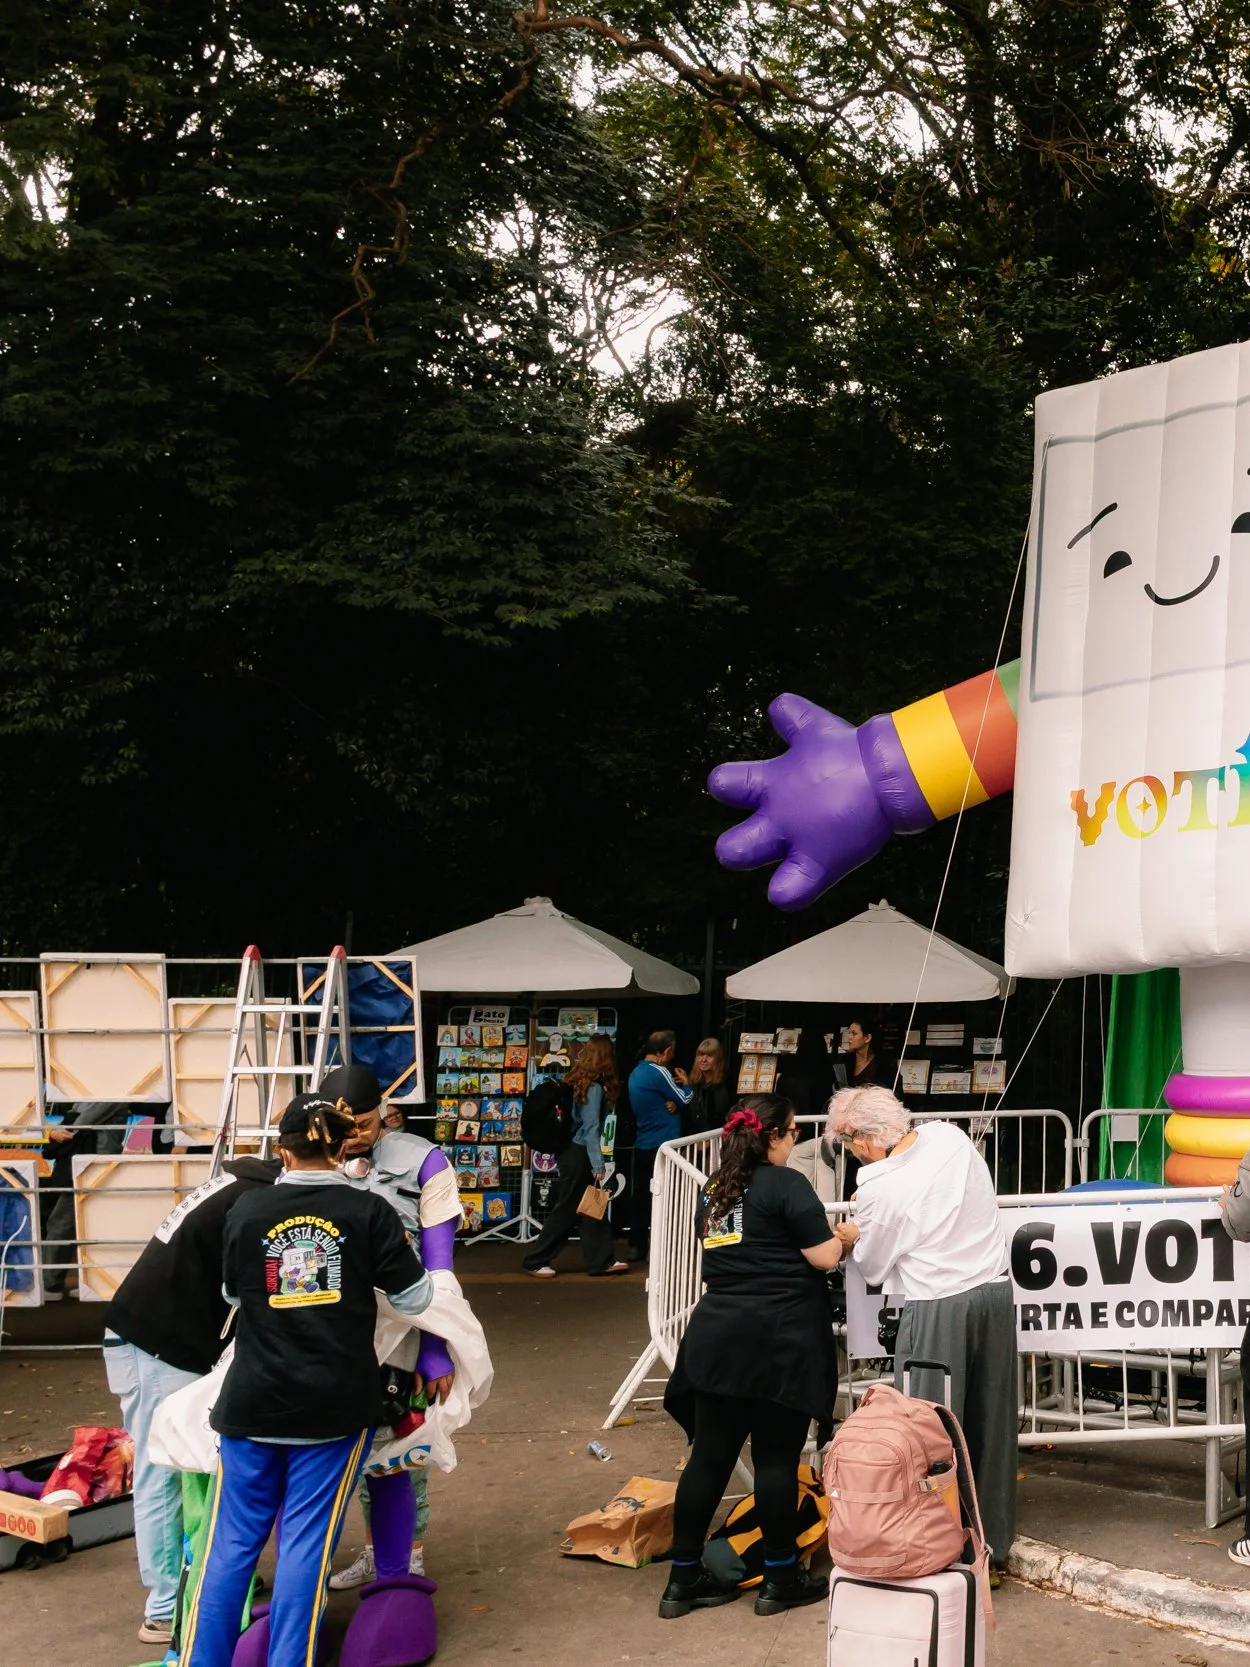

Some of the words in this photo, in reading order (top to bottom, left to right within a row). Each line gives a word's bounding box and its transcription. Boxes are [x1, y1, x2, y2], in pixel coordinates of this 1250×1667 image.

[267, 1215, 340, 1239] PRODUÇÃO
[287, 1224, 312, 1242] ESTÁ
[311, 1229, 340, 1255] SENDO
[327, 1254, 341, 1290] FILMADO
[1013, 1302, 1084, 1331] RTA
[1091, 1301, 1109, 1329] E
